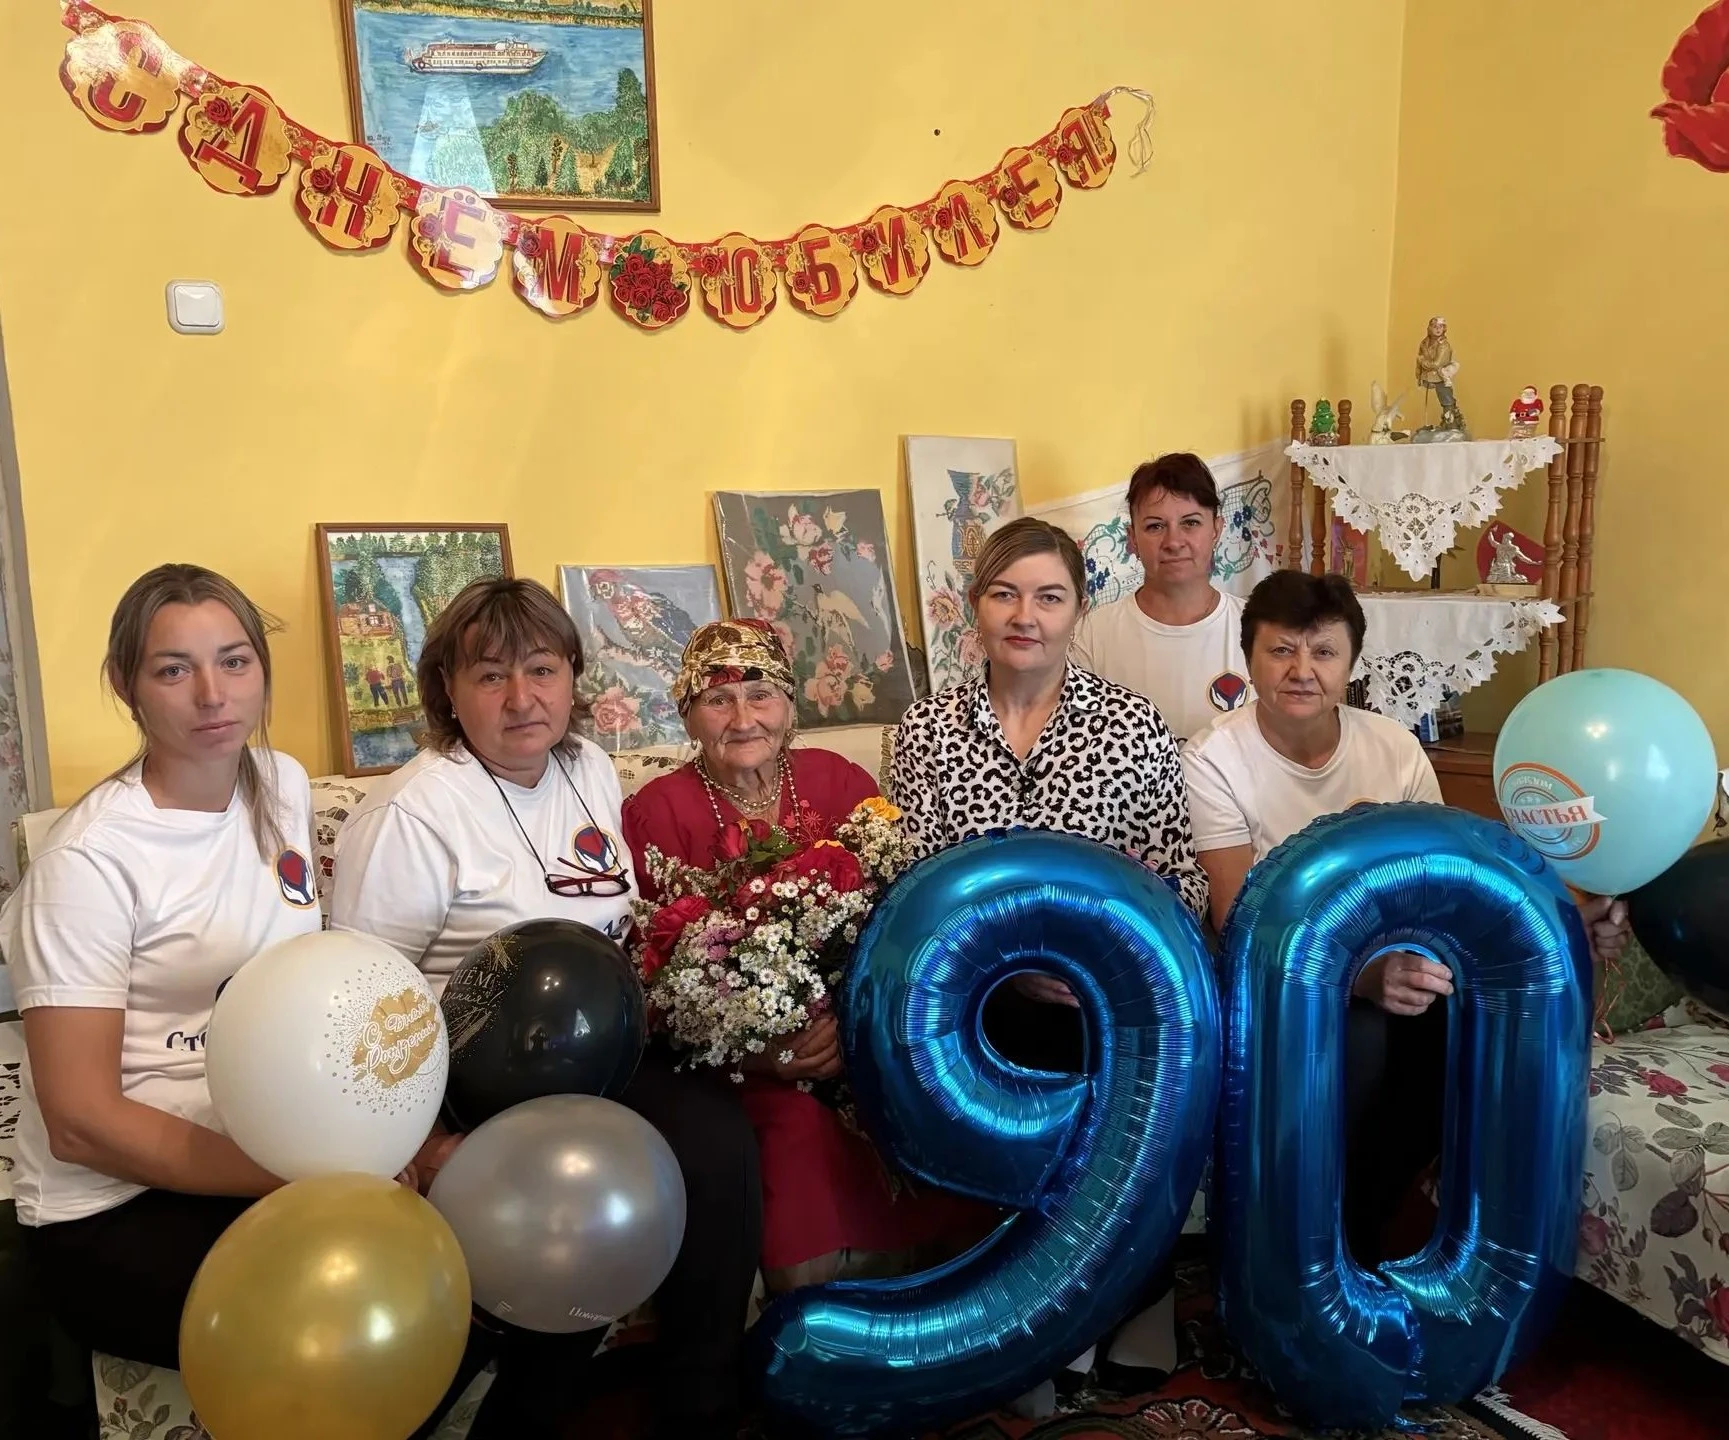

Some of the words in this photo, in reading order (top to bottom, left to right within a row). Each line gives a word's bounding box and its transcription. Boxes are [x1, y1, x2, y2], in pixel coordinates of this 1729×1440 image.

[88, 31, 163, 123] С
[195, 92, 586, 306] ДНЁМ
[363, 1021, 382, 1049] С
